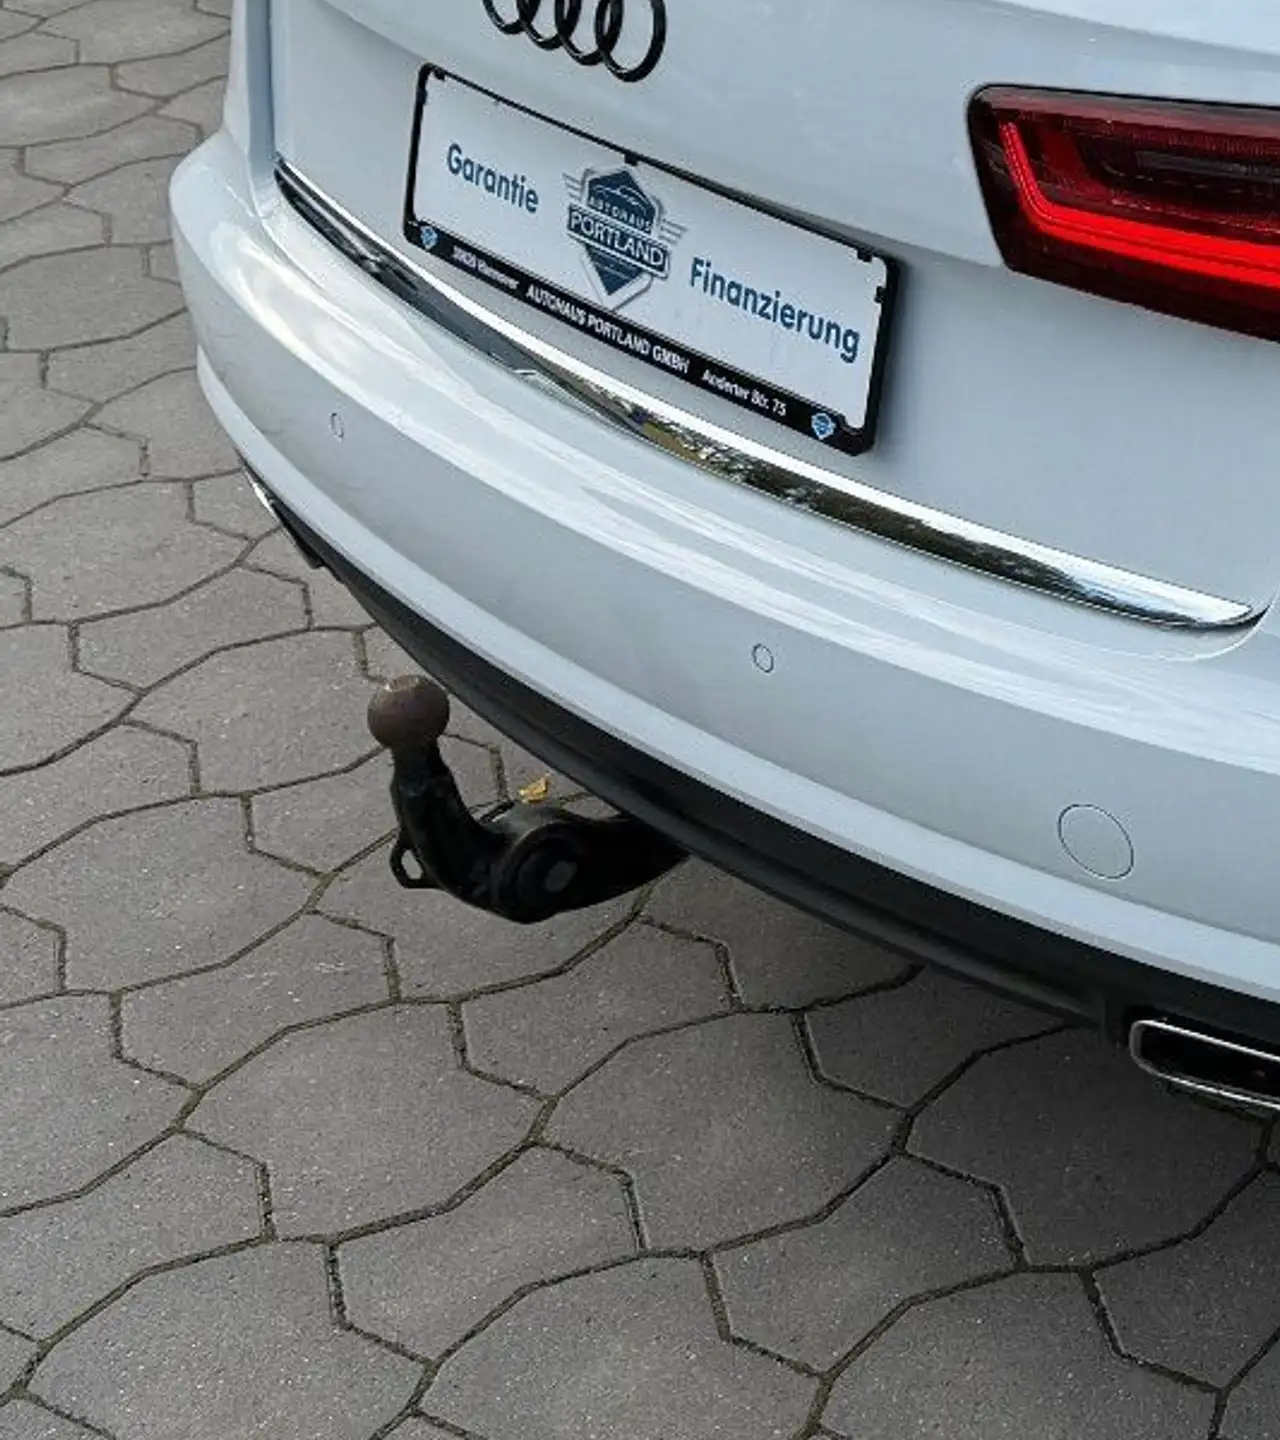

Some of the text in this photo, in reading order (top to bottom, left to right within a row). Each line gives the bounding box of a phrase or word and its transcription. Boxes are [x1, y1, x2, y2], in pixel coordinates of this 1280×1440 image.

[446, 143, 540, 215] Garantie
[588, 196, 652, 233] AUTOHAUS
[569, 210, 666, 266] PORTLAND
[525, 284, 588, 327] AUTOHAUS
[587, 316, 651, 356] PORTLAND
[690, 256, 862, 364] Finanzierung
